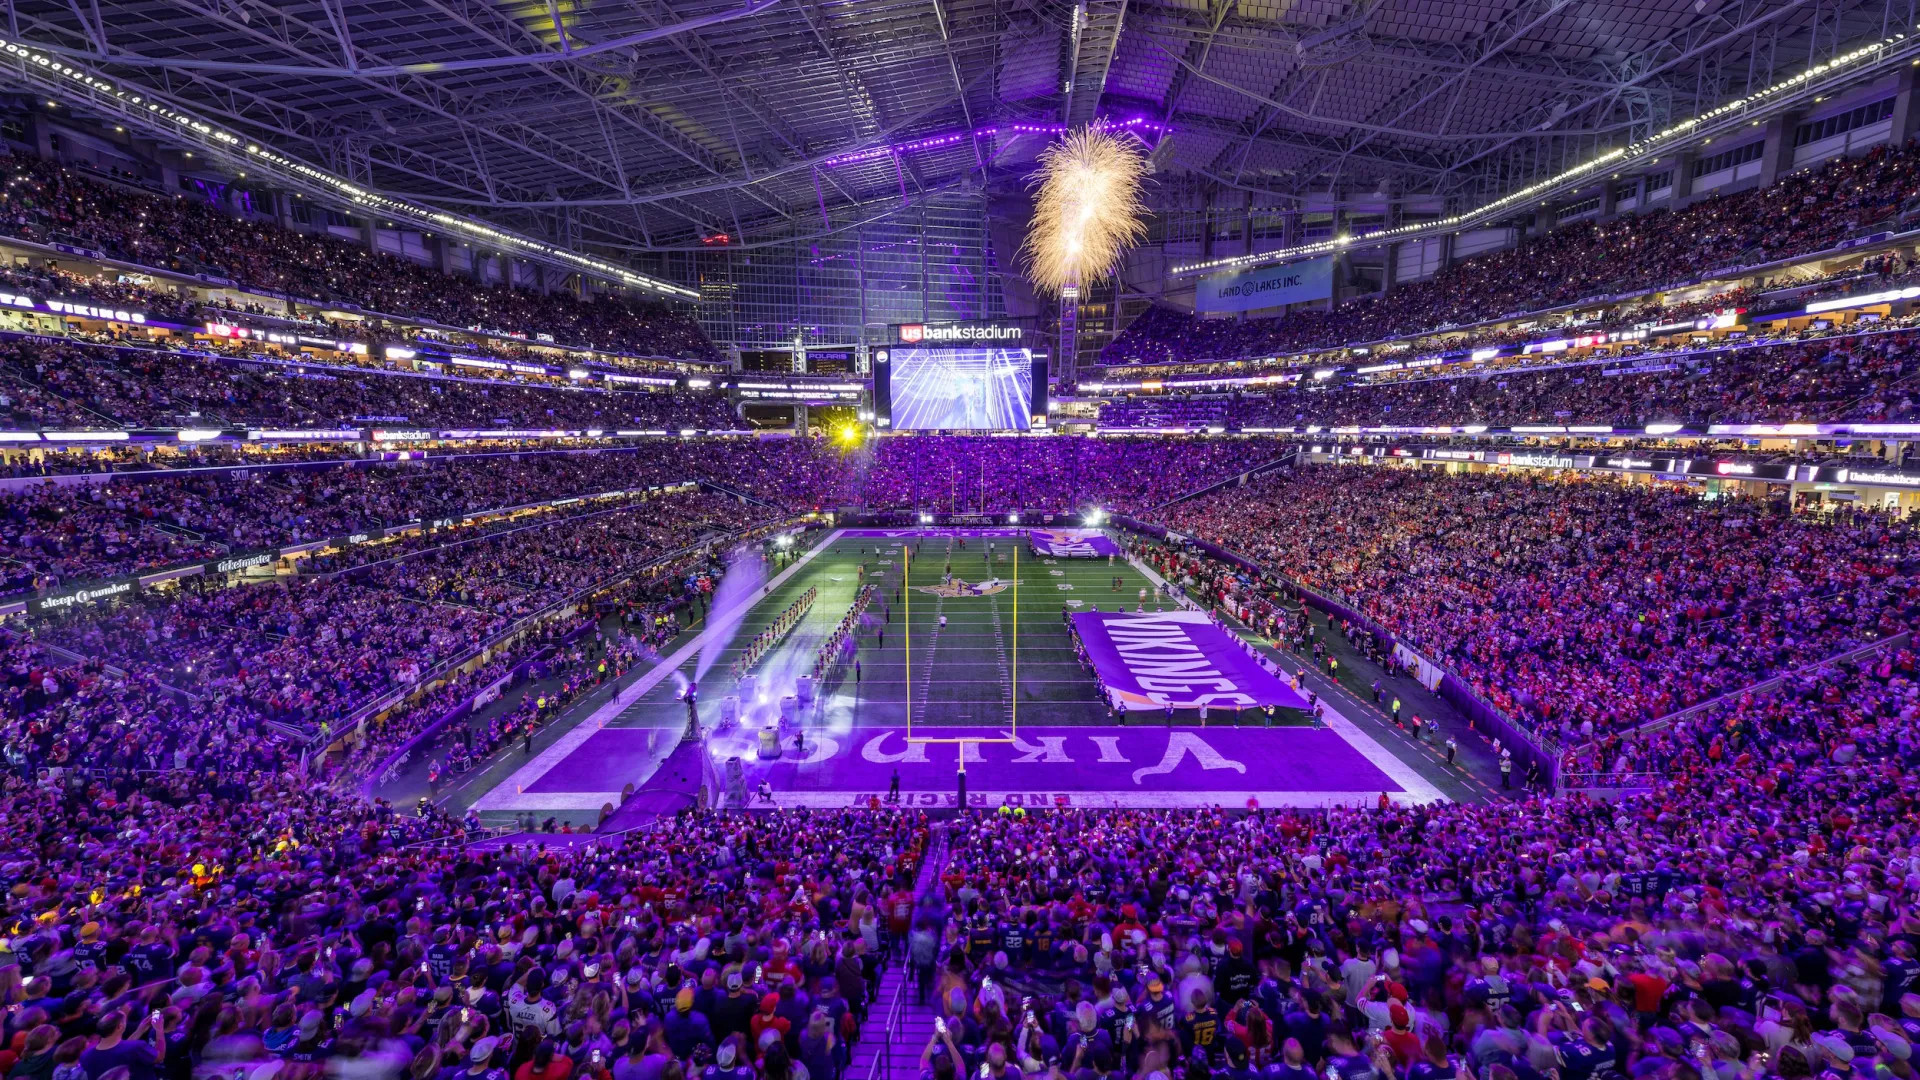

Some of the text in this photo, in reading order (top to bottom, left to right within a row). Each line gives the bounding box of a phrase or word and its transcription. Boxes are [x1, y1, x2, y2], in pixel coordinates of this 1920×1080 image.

[1218, 286, 1241, 298] LAND
[1283, 275, 1302, 288] INC.
[46, 300, 146, 324] VIKINGS
[217, 554, 272, 573] ticketmaster
[40, 583, 132, 609] sleep number
[1102, 617, 1258, 706] VIKINGS
[1193, 1027, 1216, 1046] 18
